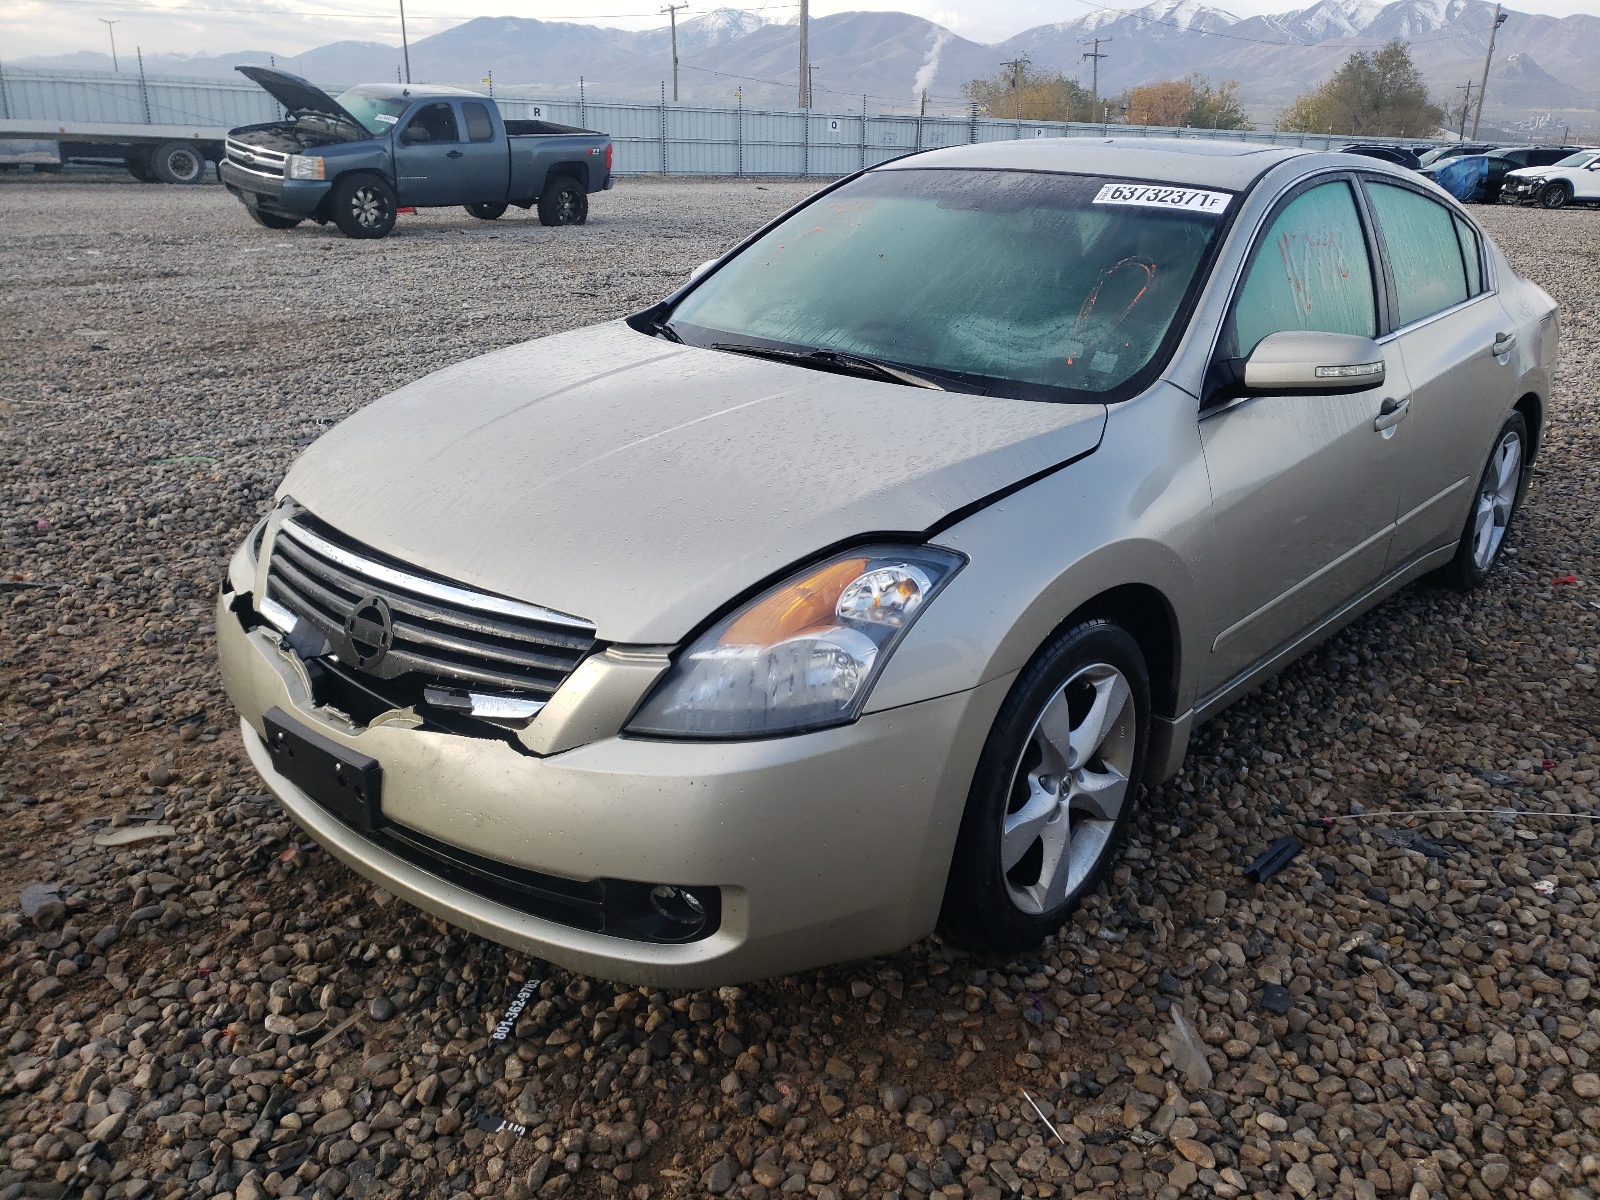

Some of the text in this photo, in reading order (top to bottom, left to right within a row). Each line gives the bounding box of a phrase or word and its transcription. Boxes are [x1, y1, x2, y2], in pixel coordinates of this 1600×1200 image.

[533, 107, 541, 117] R
[831, 121, 837, 129] Q
[1110, 187, 1211, 206] 63732371
[1209, 198, 1220, 207] F
[493, 980, 541, 1039] 801-362-9783
